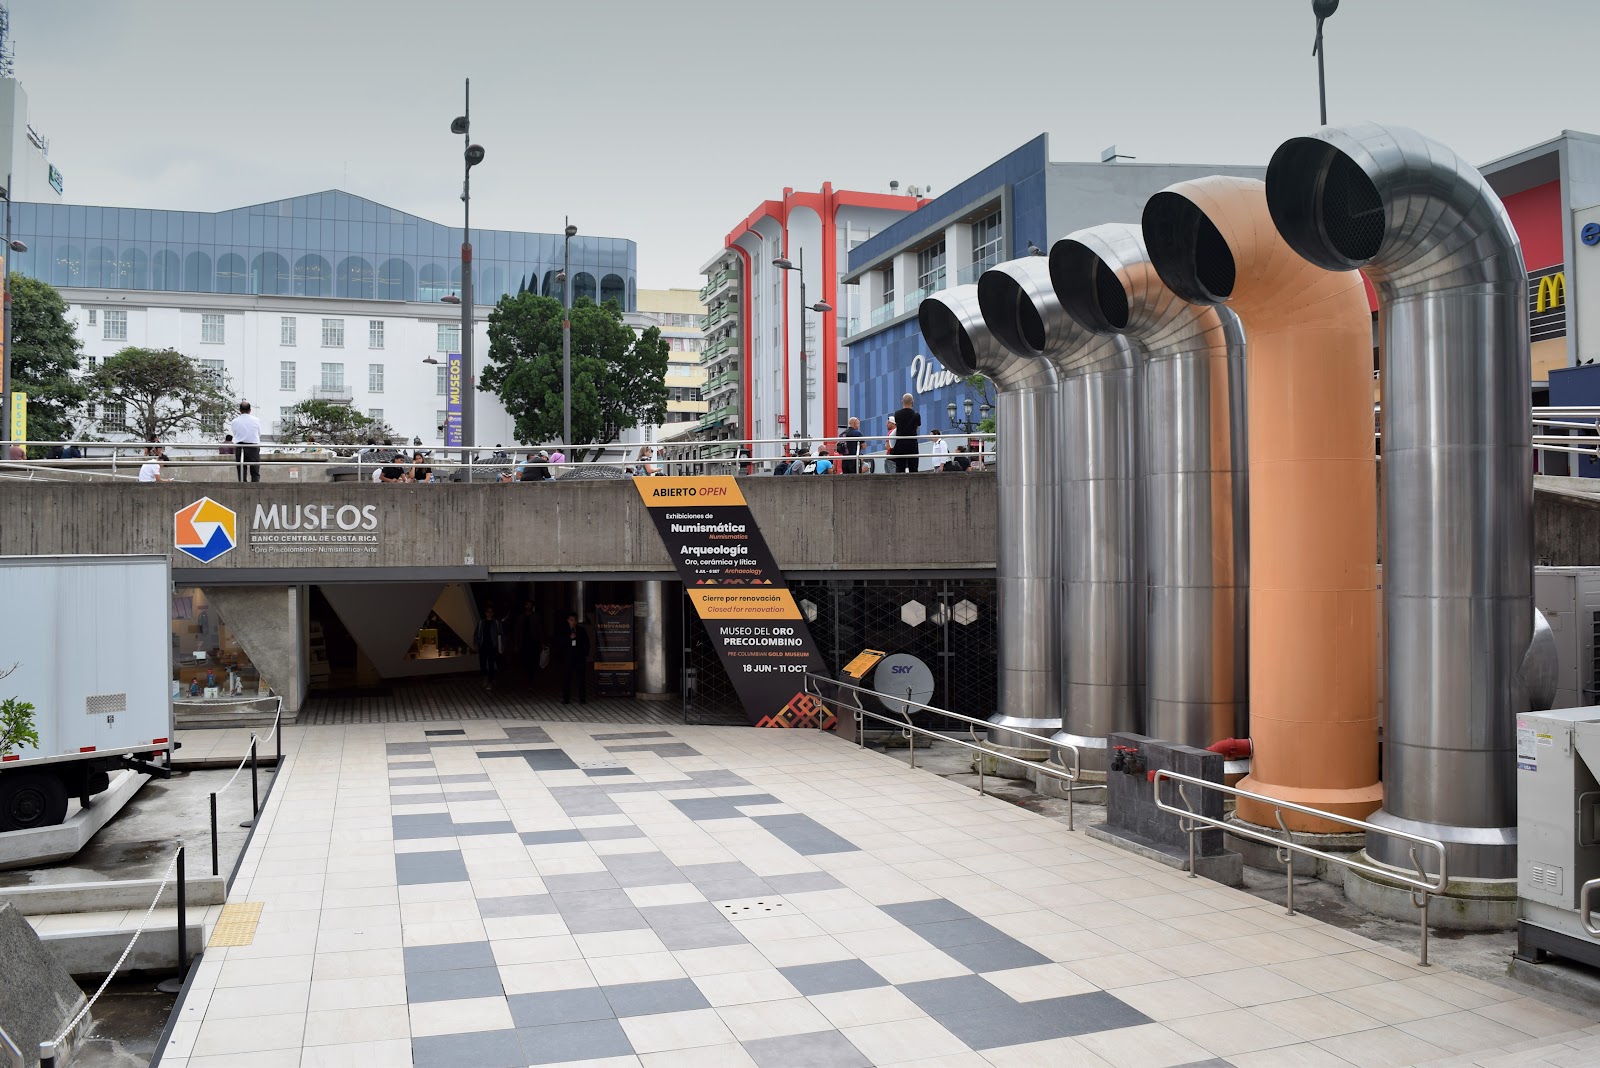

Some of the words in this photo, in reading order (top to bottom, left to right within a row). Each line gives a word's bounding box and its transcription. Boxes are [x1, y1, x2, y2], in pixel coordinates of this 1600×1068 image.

[450, 359, 460, 404] MUSEOS
[652, 487, 697, 497] ABIERTO
[699, 487, 727, 496] OPEN
[252, 503, 378, 530] MUSEOS
[671, 523, 746, 533] Numismática
[680, 544, 748, 556] Arqueología
[684, 558, 699, 566] Oro,
[702, 594, 724, 602] Cierre
[738, 594, 781, 602] renovación
[707, 605, 733, 613] Closed
[734, 605, 744, 613] for
[744, 605, 785, 613] renovation
[720, 626, 752, 636] MUSEO
[754, 626, 770, 636] DEL
[772, 626, 794, 636] ORO
[723, 637, 803, 646] PRECOLOMBINO
[742, 664, 752, 673] 18
[753, 664, 772, 673] JUN
[779, 664, 787, 673] 11
[787, 664, 808, 673] OCT
[891, 665, 913, 674] SKY
